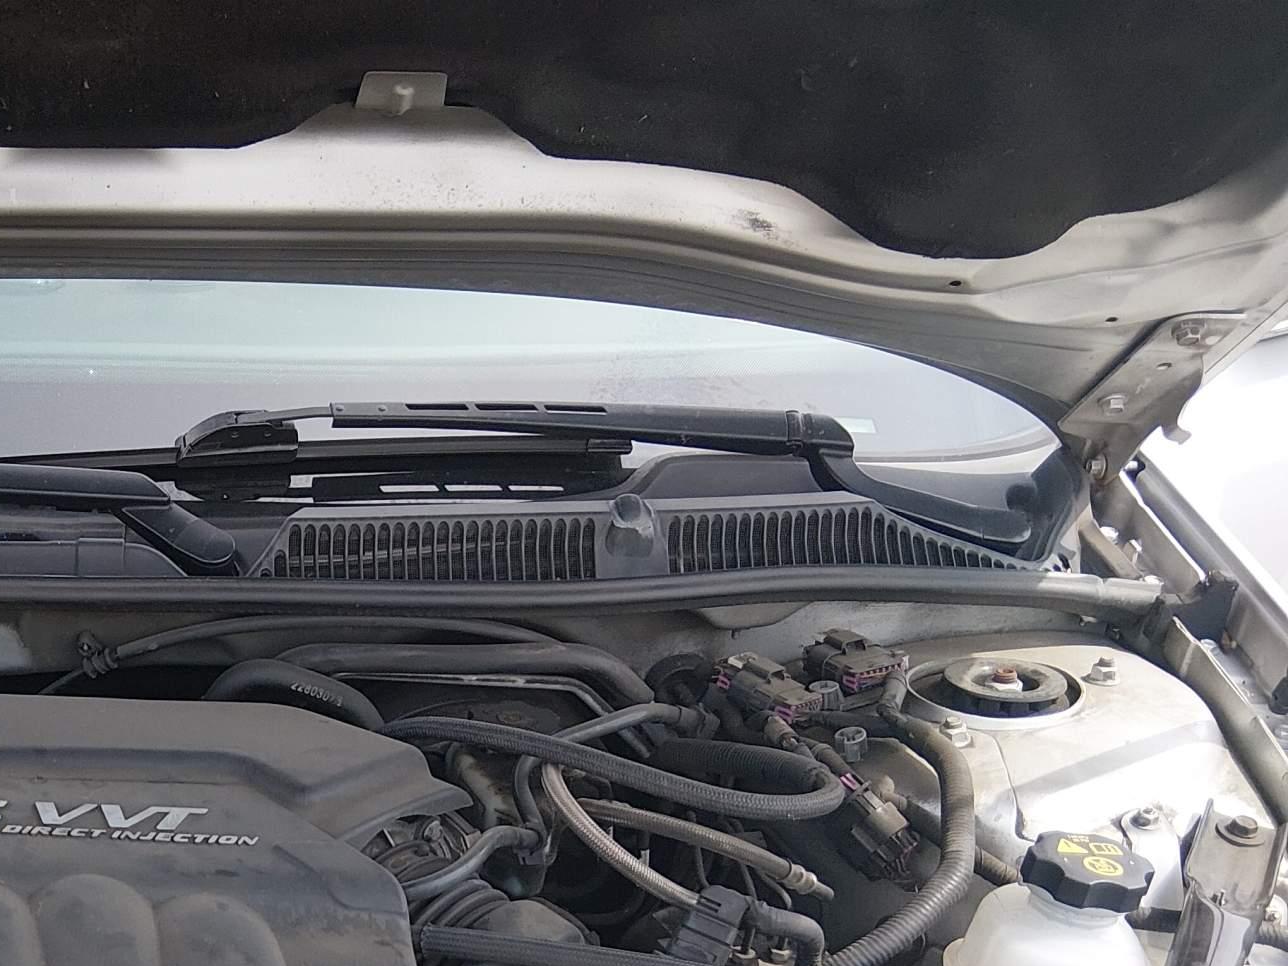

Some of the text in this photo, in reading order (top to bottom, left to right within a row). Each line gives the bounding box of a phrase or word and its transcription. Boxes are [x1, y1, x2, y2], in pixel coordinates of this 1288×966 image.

[34, 801, 209, 831] VVT
[1, 824, 259, 846] DIRECT INJECTION
